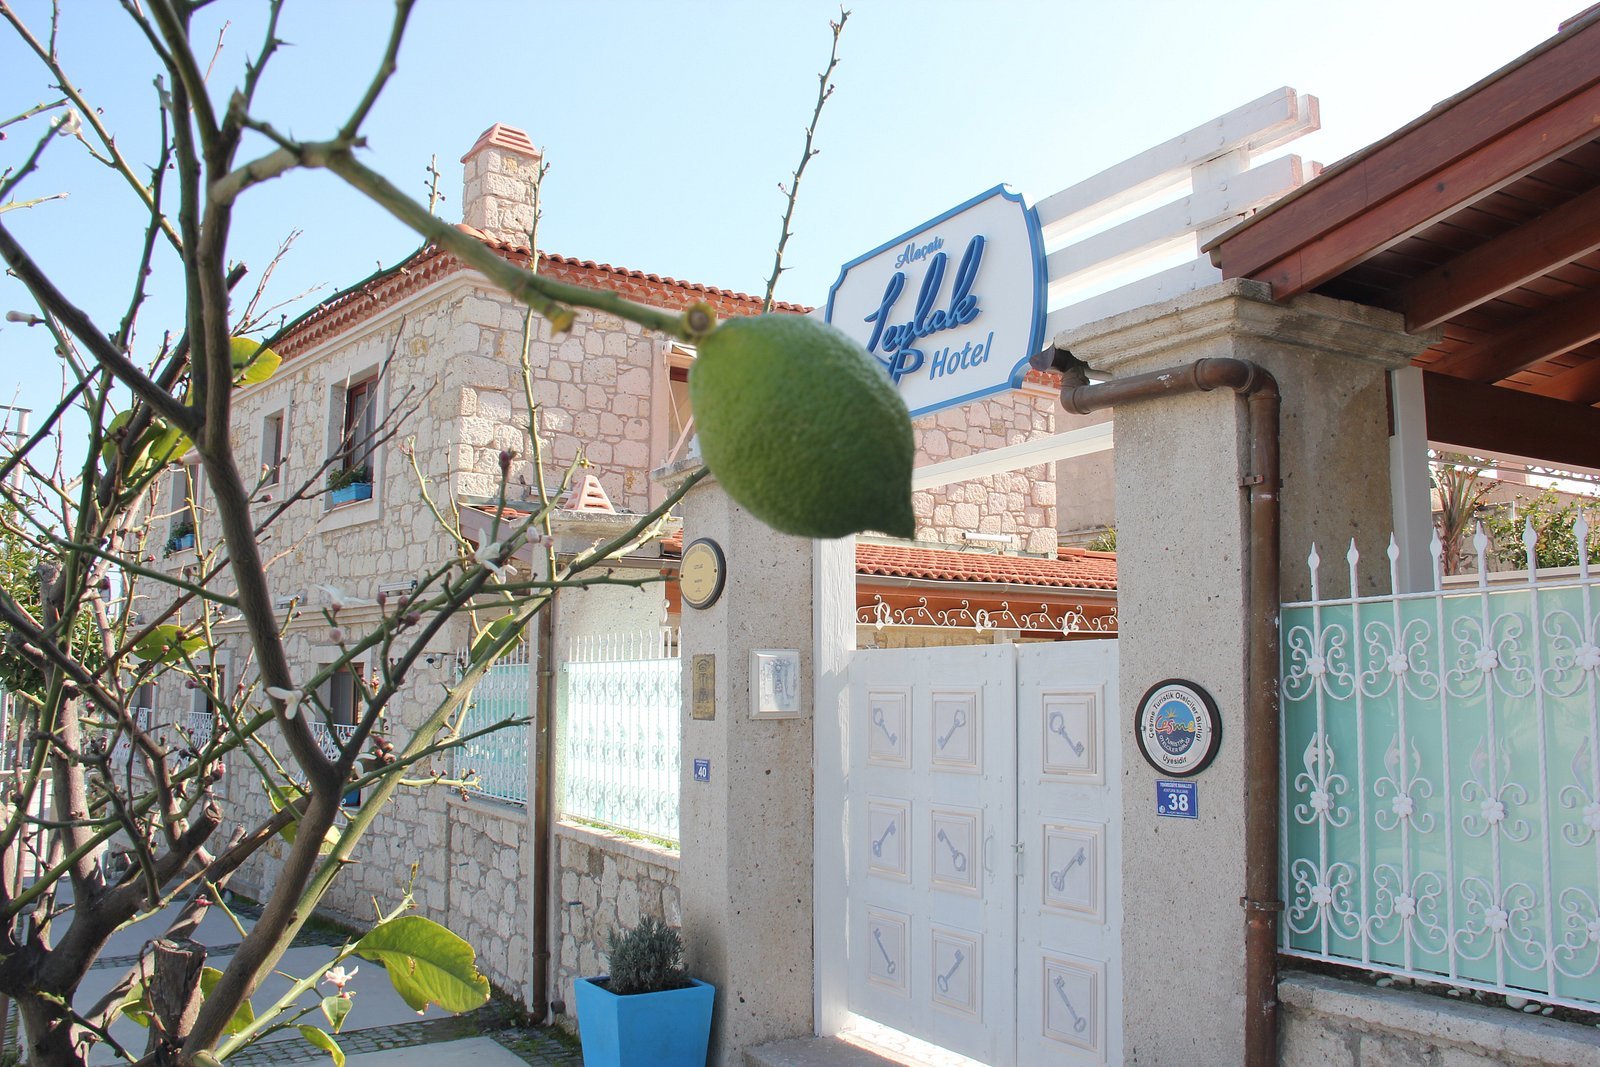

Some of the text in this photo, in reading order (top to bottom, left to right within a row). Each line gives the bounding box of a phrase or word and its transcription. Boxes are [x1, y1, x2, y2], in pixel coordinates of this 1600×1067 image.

[929, 331, 994, 380] Hotel
[697, 766, 707, 778] 40
[1168, 793, 1189, 812] 38
